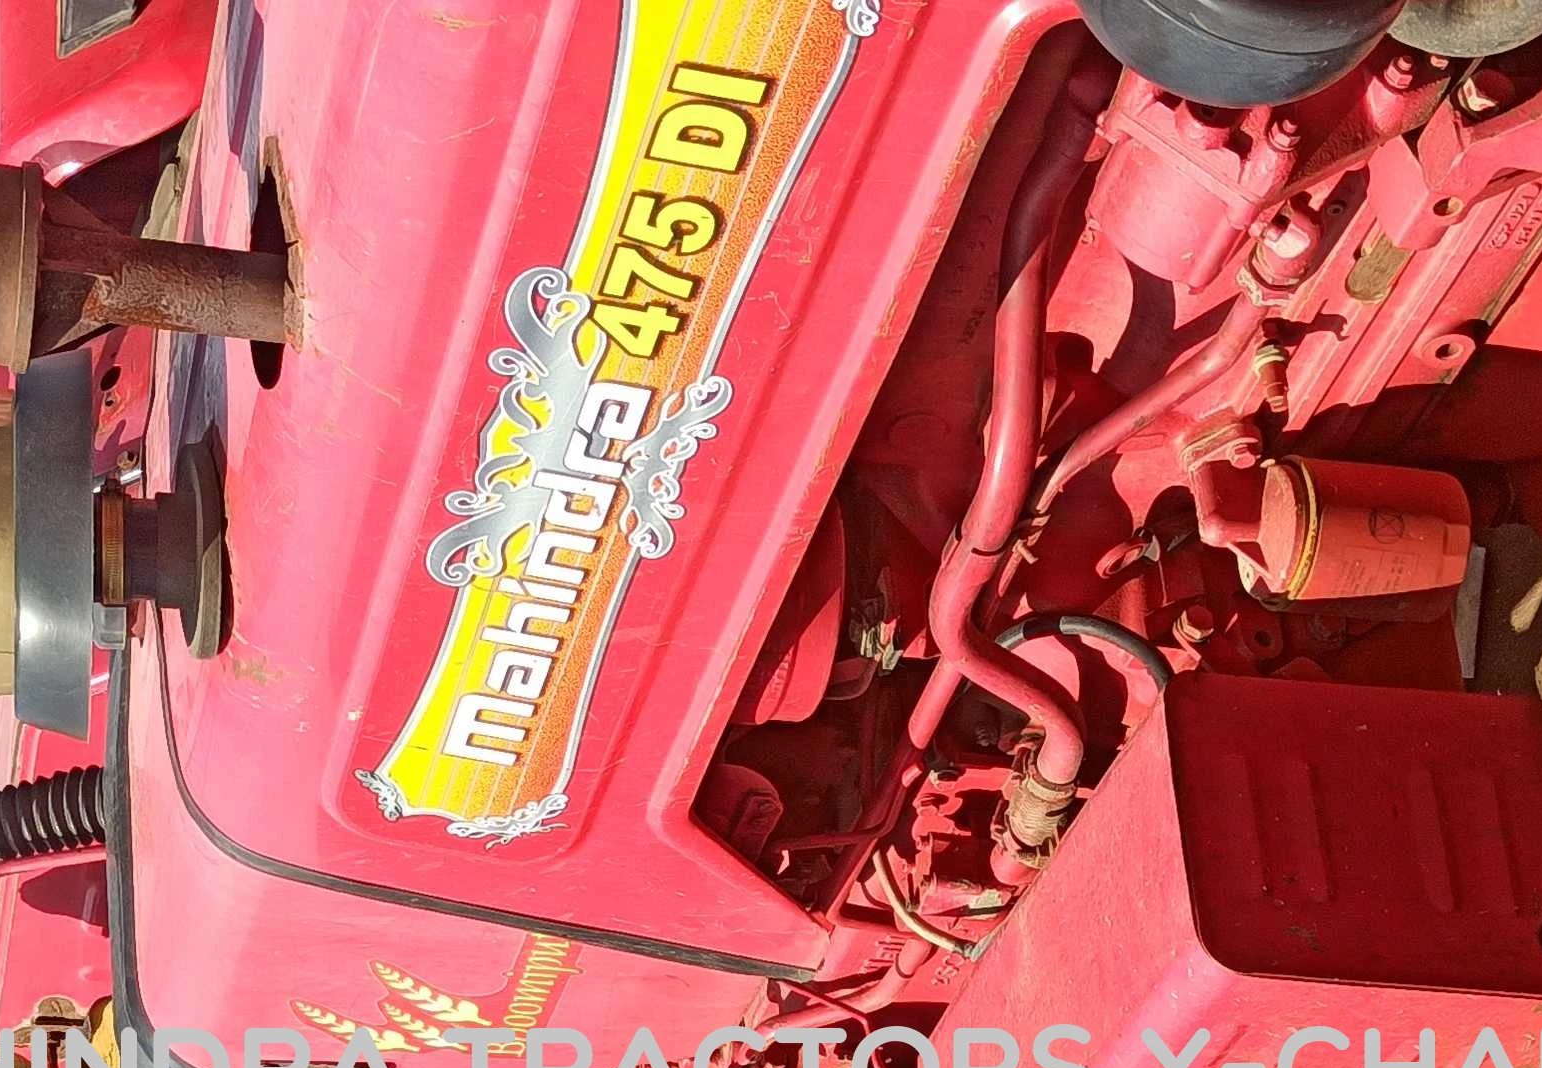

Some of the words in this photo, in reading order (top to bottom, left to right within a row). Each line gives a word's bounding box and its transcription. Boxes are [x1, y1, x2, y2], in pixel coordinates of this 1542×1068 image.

[645, 62, 778, 173] DI
[587, 191, 726, 360] 475
[442, 380, 654, 767] Mahindra
